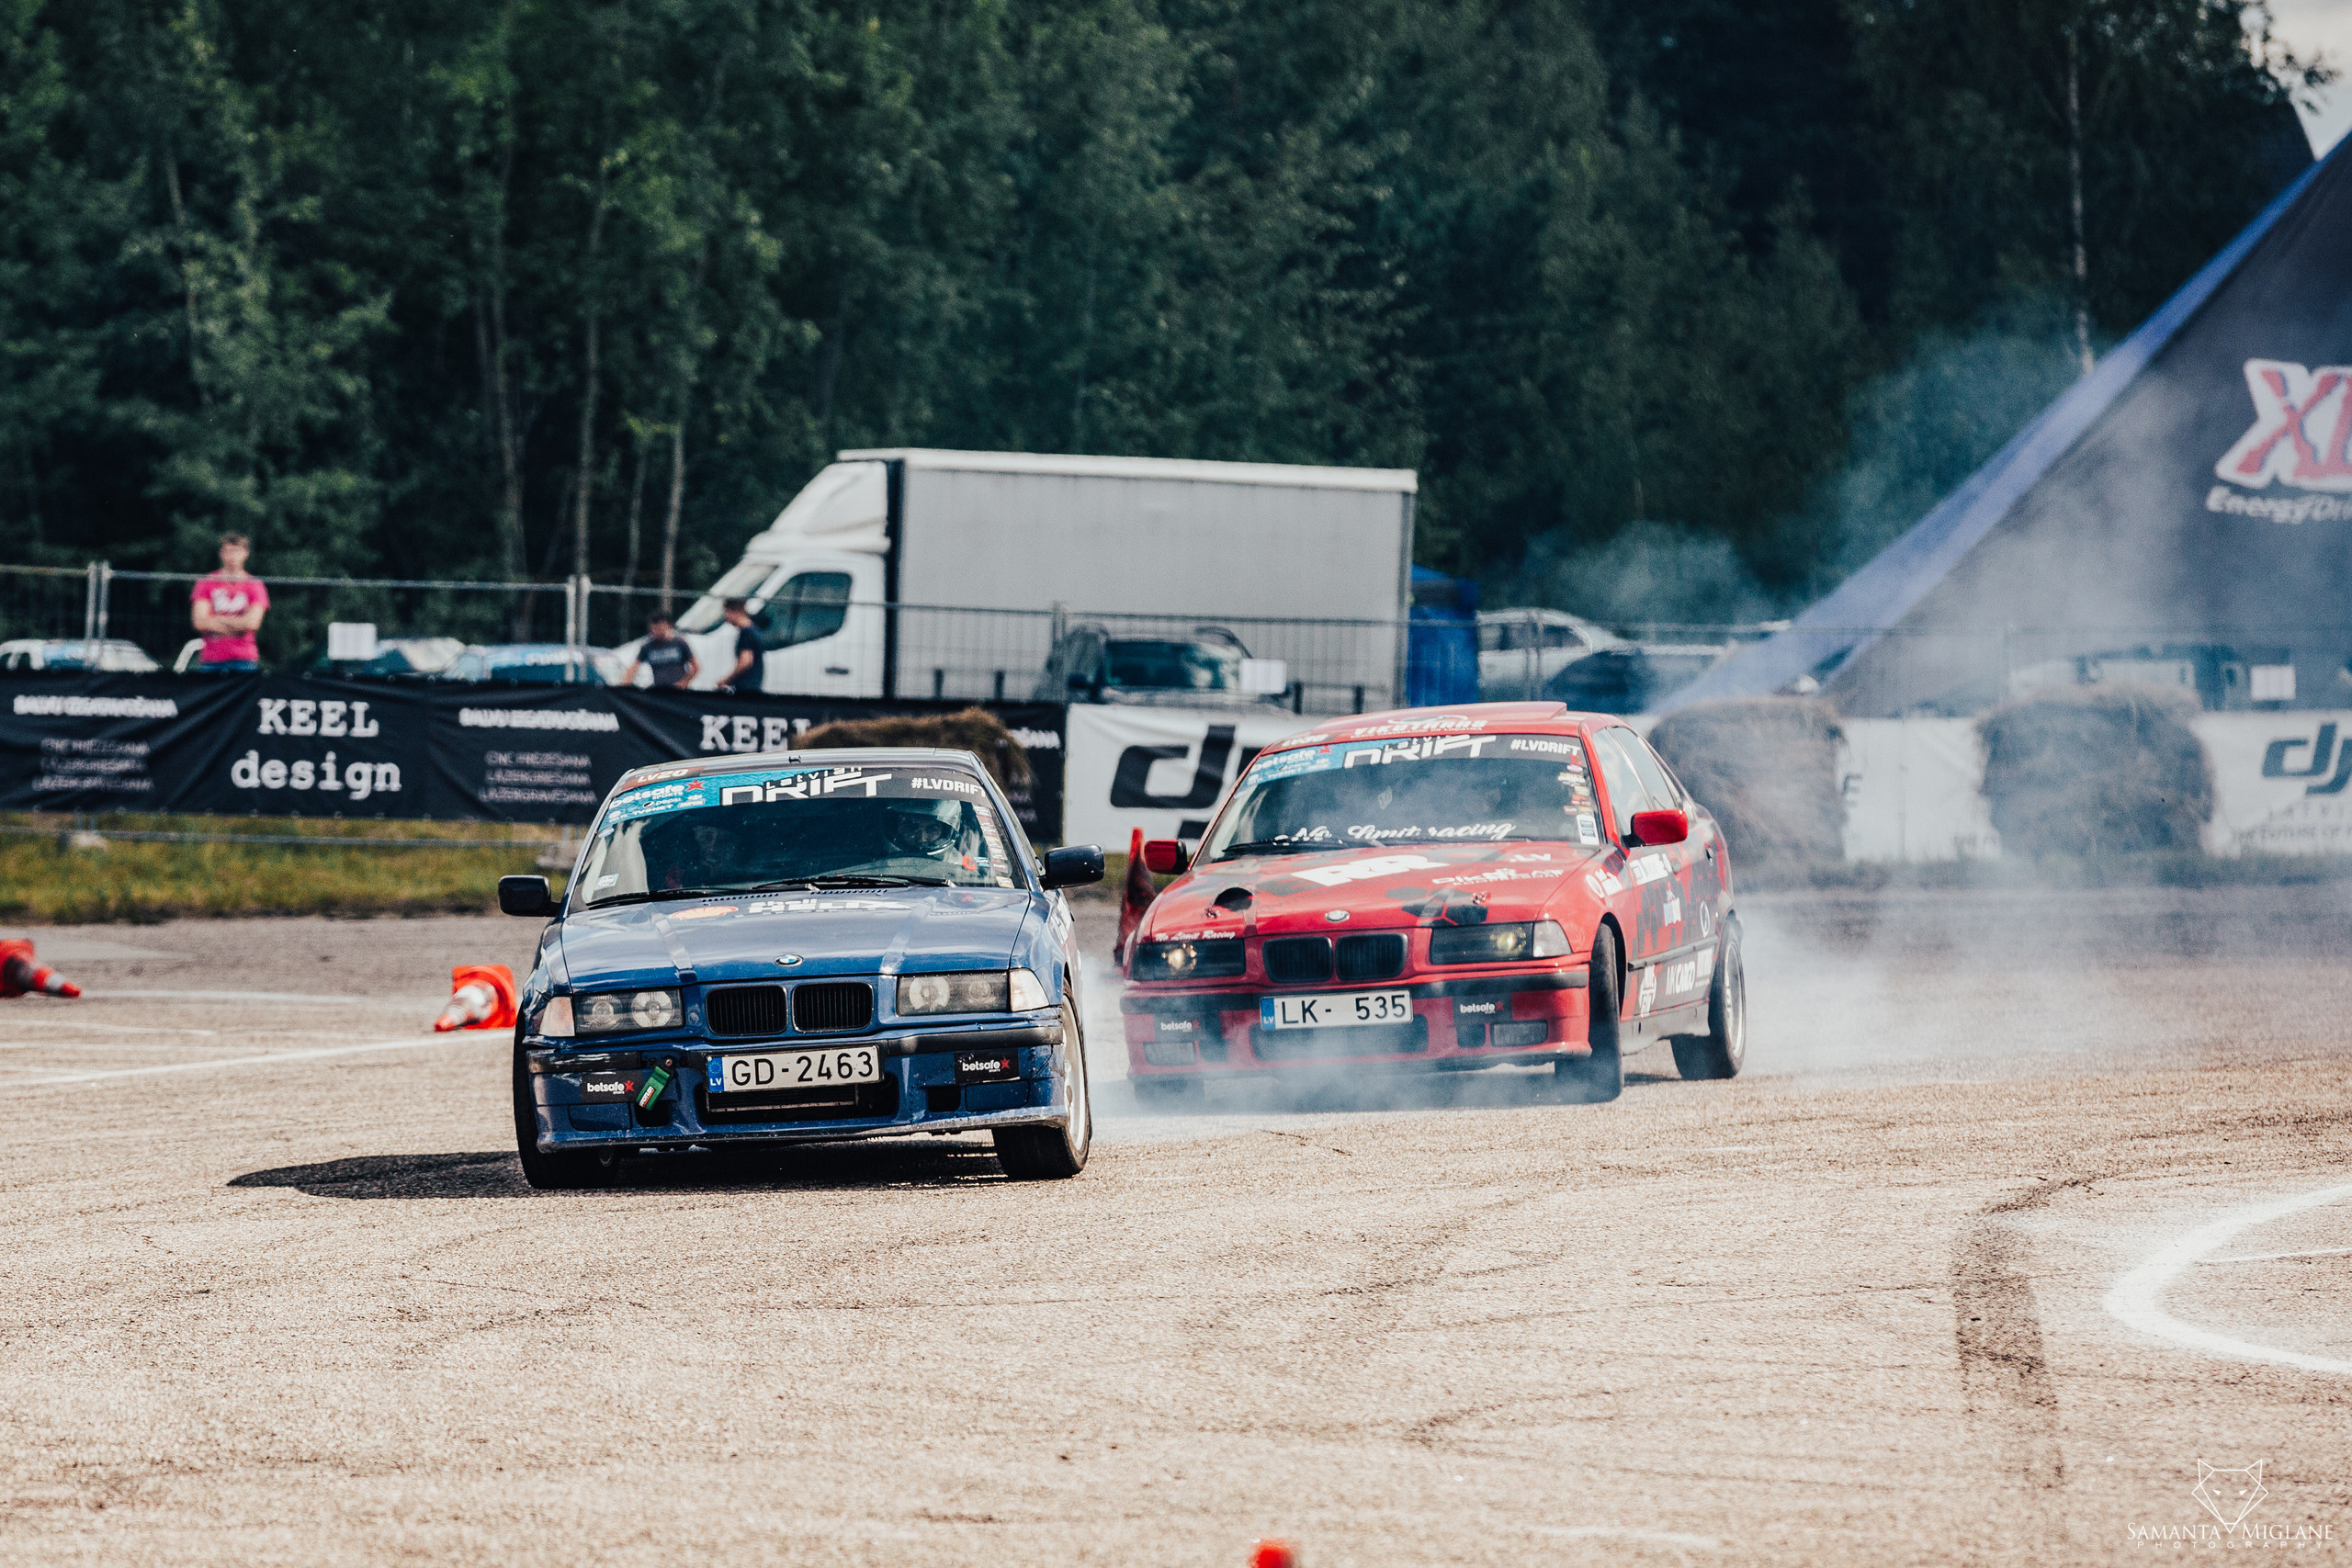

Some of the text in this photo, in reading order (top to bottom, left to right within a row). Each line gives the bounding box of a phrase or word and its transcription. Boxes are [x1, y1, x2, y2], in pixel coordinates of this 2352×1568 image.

[256, 697, 379, 738] KEEL
[1510, 739, 1581, 756] #LVDRIFT
[2261, 721, 2352, 795] dj
[231, 750, 401, 801] design
[637, 769, 689, 783] LV20
[911, 777, 987, 797] #LVDRIFT
[609, 784, 685, 808] betsafe
[1428, 822, 1516, 840] racing
[1460, 1002, 1496, 1013] betsafe
[1160, 1020, 1193, 1032] betsafe
[1262, 1016, 1274, 1025] LV
[731, 1051, 874, 1086] GD-2463
[962, 1059, 1001, 1071] betsafe
[587, 1081, 625, 1092] betsafe
[709, 1077, 722, 1087] LV
